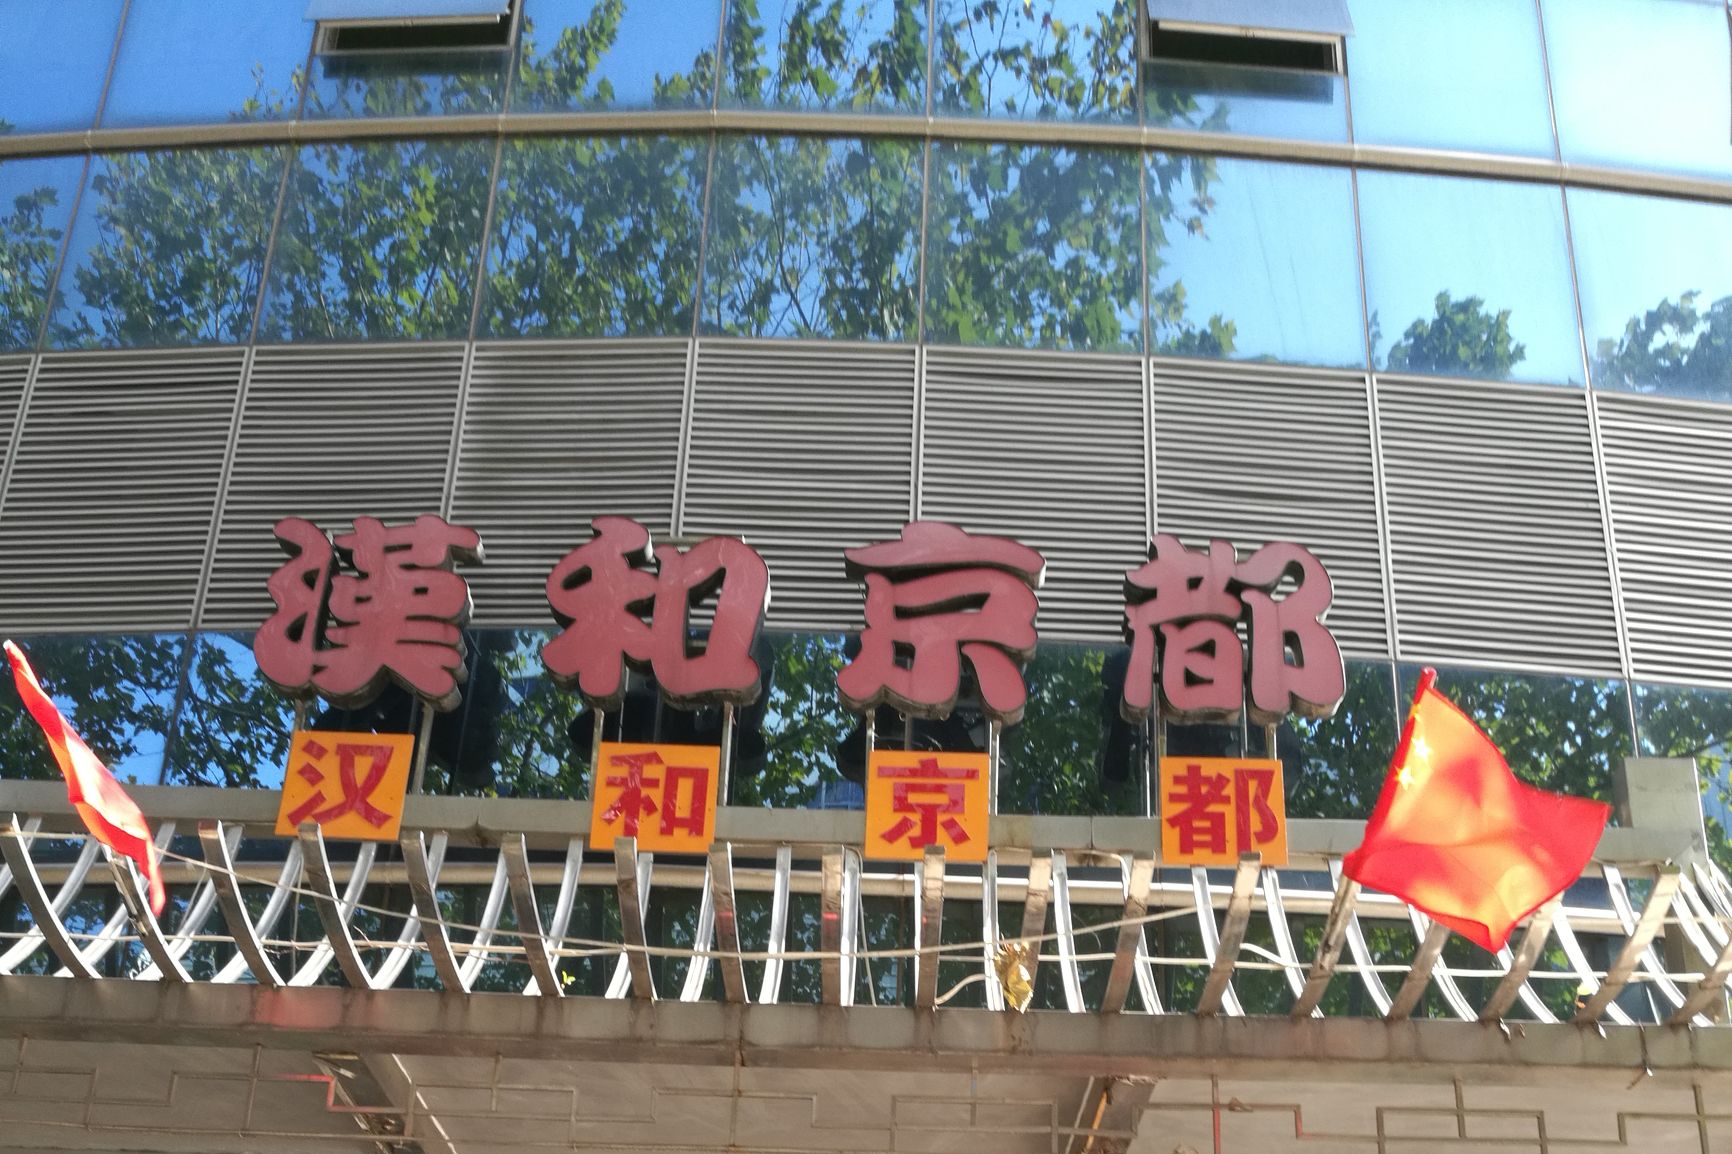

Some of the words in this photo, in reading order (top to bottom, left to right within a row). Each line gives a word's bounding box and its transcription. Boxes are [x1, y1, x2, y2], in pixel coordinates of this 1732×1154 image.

[253, 514, 1347, 727] 漢和京都
[287, 740, 1279, 856] 汉和京都
